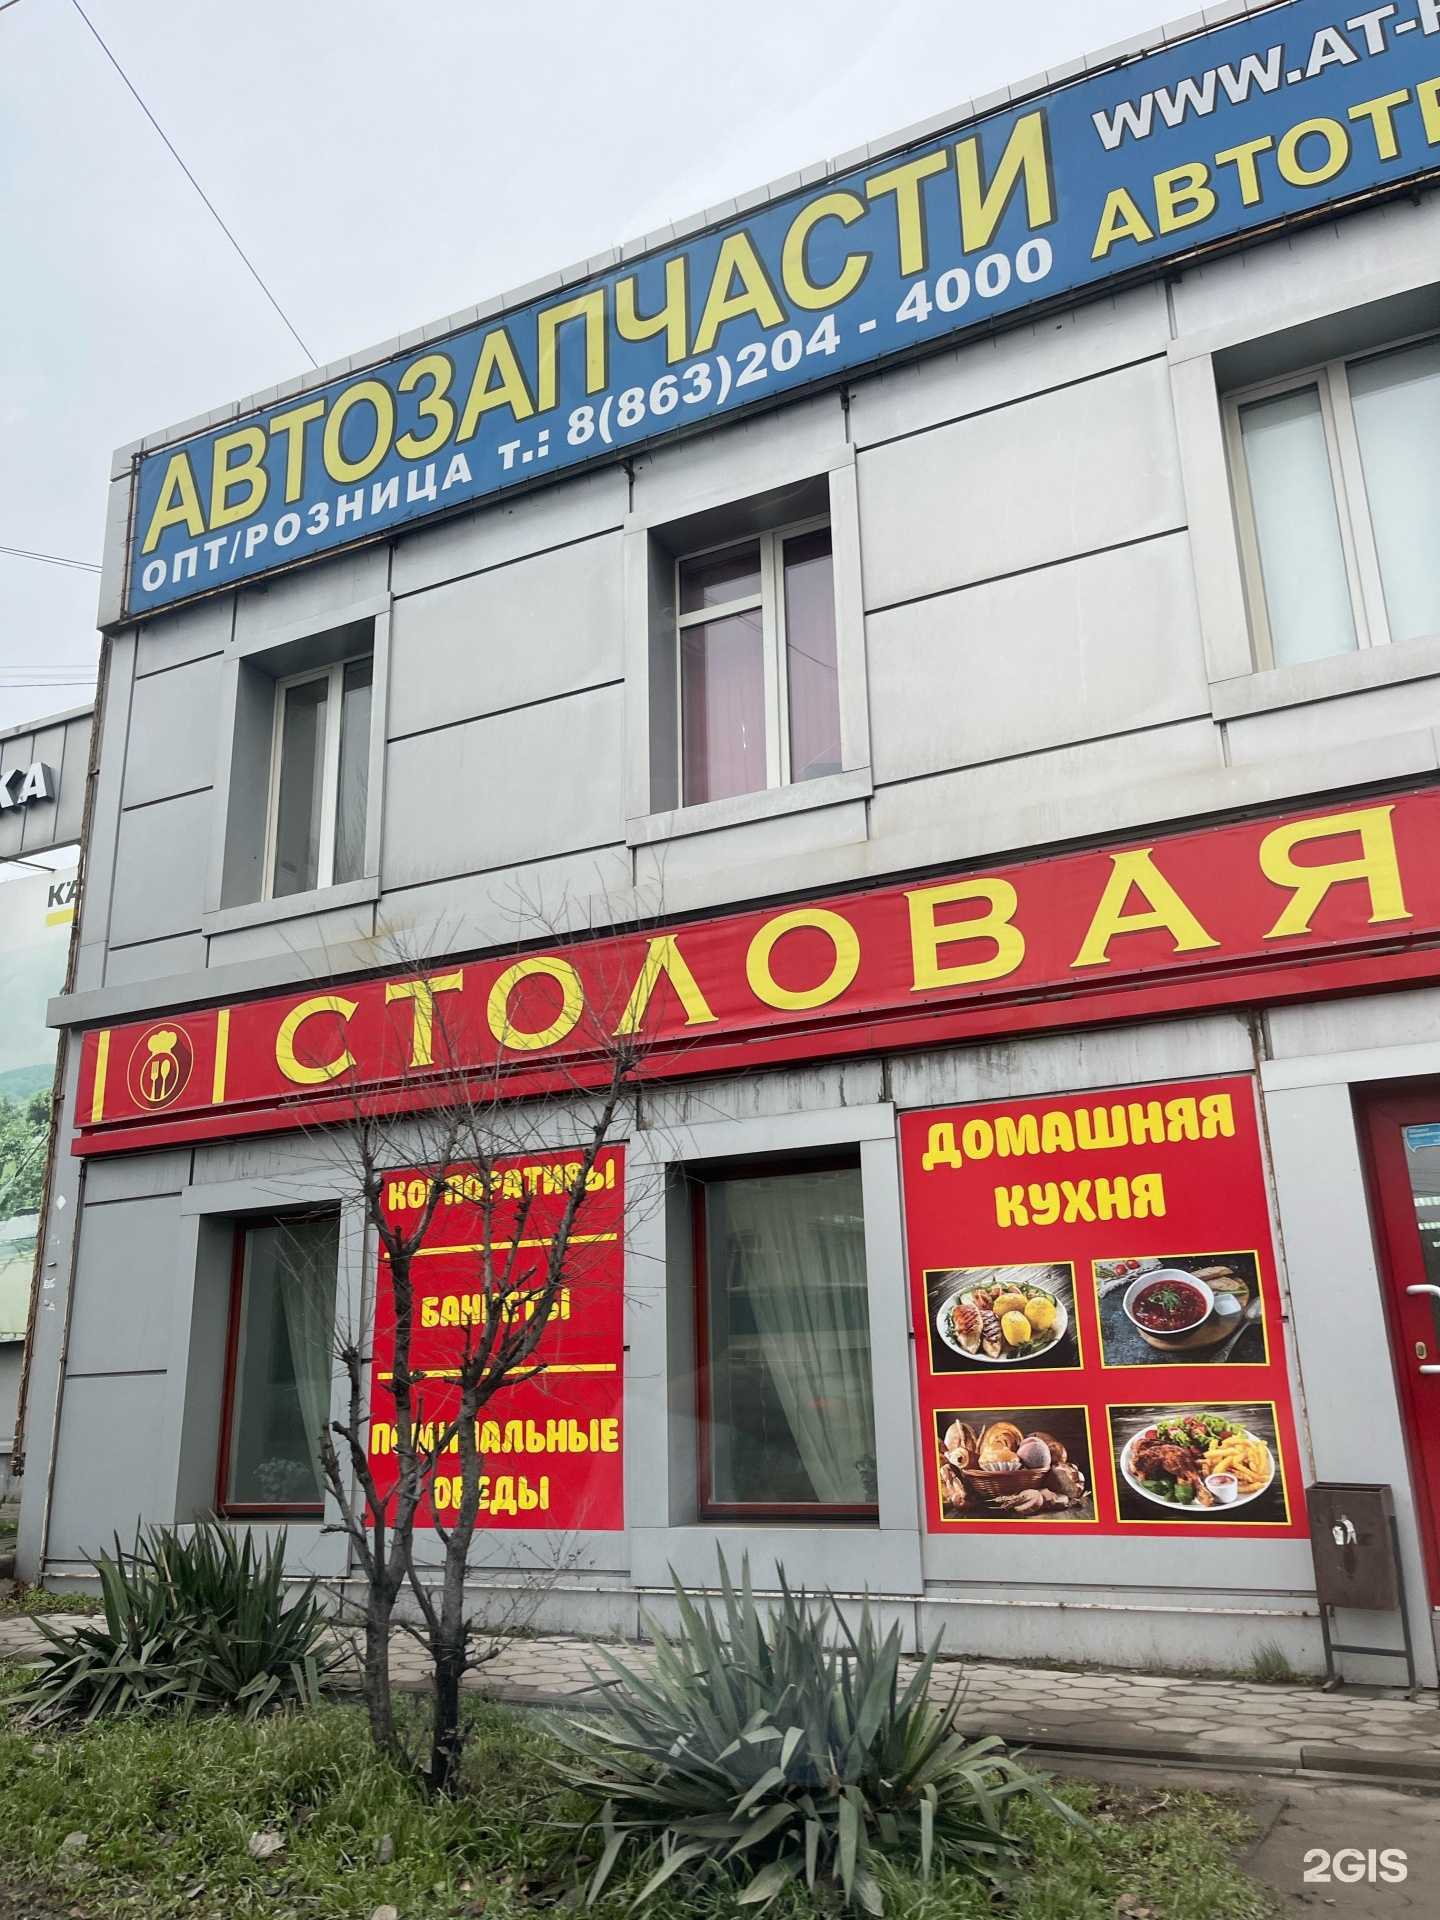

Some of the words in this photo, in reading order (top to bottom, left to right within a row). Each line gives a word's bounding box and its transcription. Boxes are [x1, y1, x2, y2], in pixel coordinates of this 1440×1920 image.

[141, 110, 1054, 555] АВТОЗАПЧАСТИ
[141, 454, 472, 592] ОПТ/РОЗНИЦА
[566, 315, 840, 446] 8(863)204
[896, 238, 1053, 324] 4000
[276, 804, 1413, 1084] СТОЛОВАЯ
[922, 1093, 1236, 1171] ДОМАШНЯЯ
[995, 1173, 1166, 1228] КУХНЯ
